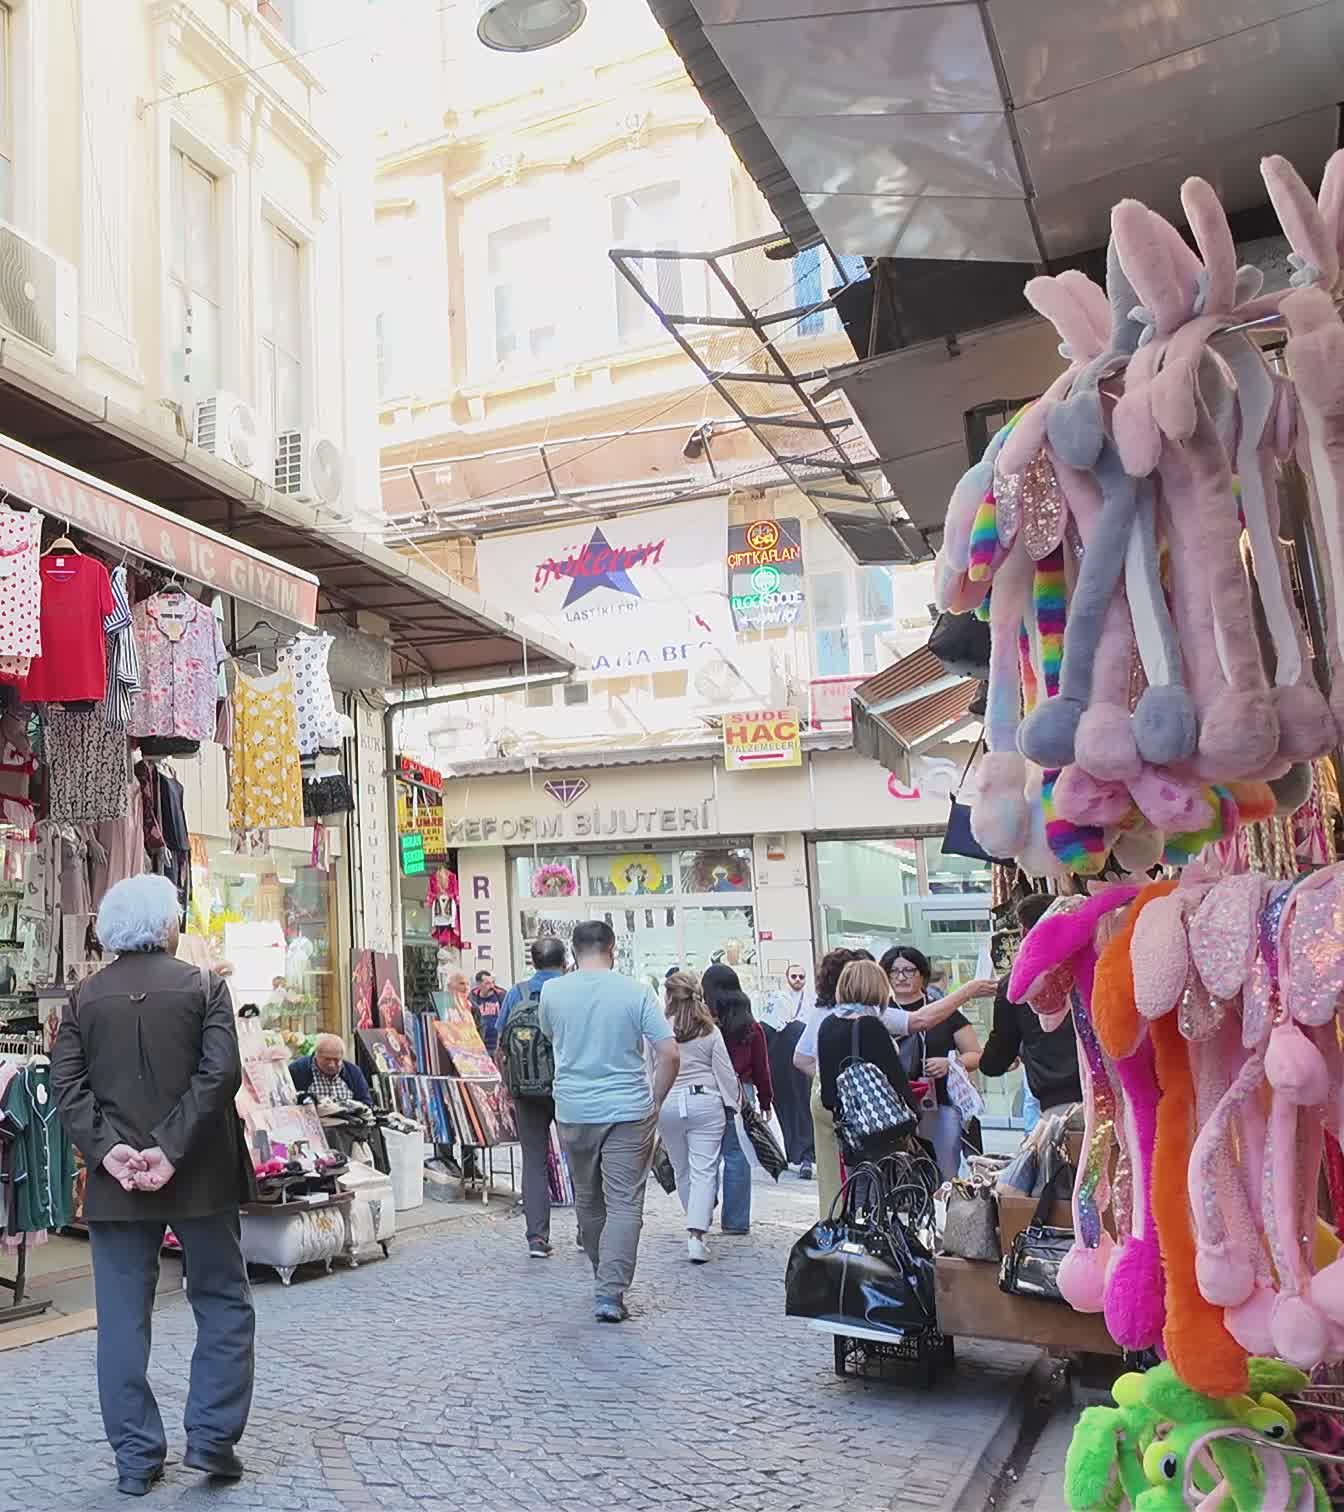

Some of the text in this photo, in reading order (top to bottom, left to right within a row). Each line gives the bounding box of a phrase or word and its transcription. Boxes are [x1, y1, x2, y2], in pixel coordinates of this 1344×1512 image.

[159, 530, 177, 561] &
[731, 710, 790, 723] SUDE
[726, 721, 796, 744] HAC
[575, 800, 710, 836] BİJUTERİ
